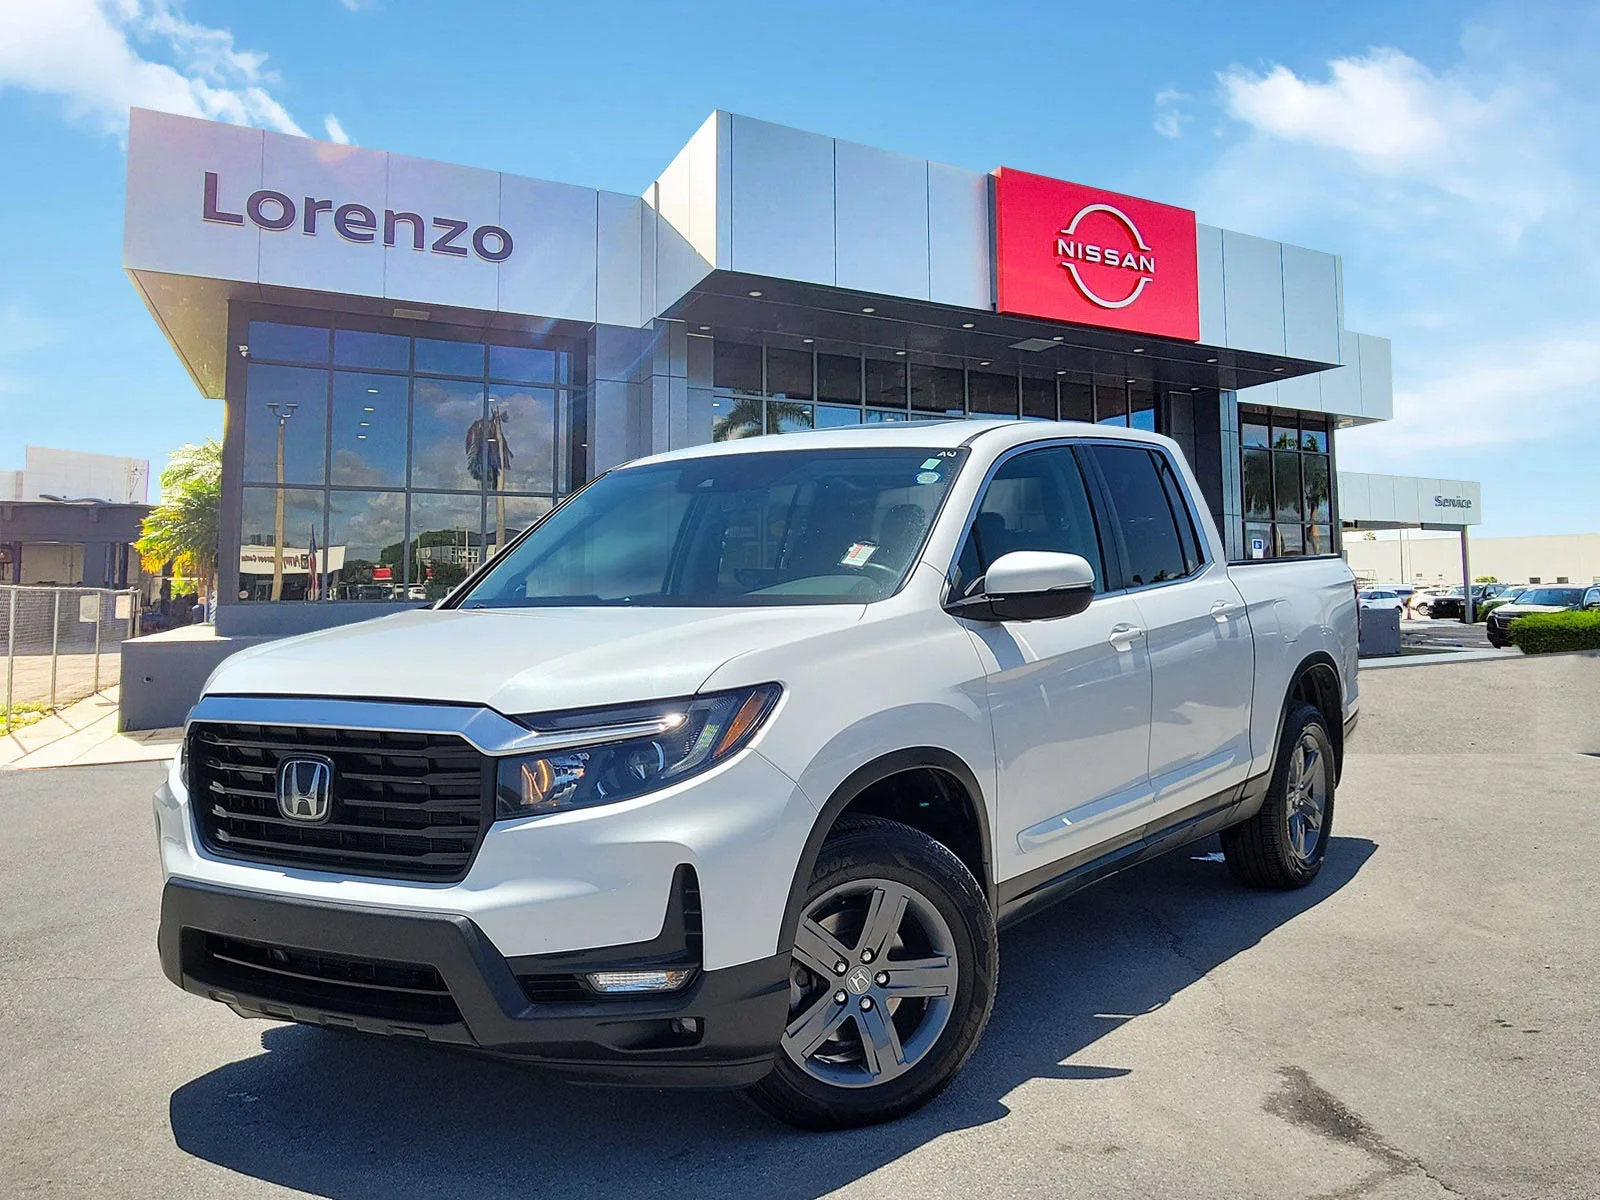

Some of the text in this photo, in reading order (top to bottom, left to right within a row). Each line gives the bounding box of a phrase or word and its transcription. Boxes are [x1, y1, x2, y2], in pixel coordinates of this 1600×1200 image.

[203, 171, 513, 262] Lorenzo
[1058, 238, 1155, 273] NISSAN
[1434, 495, 1472, 508] Service
